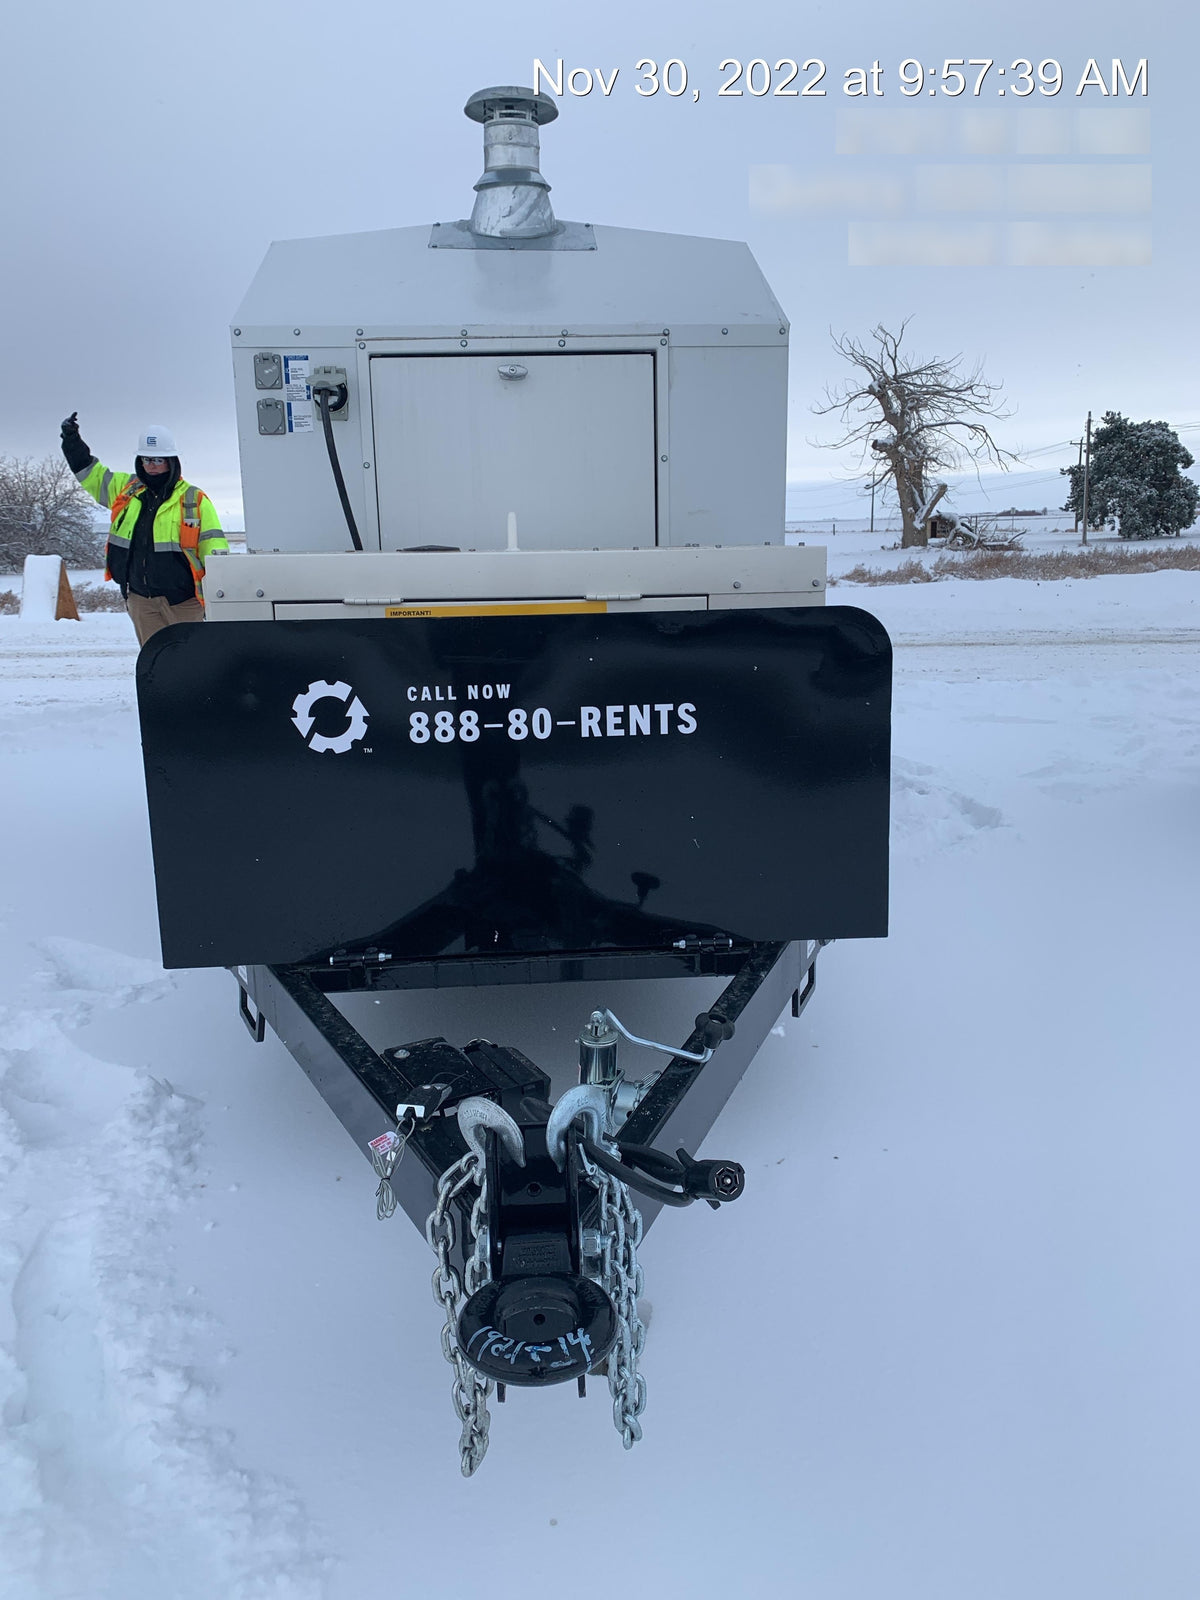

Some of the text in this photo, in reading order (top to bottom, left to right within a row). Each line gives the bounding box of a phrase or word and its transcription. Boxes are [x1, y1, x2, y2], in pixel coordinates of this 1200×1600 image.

[407, 683, 511, 702] CALL NOW
[408, 702, 698, 744] 888-80-RENTS
